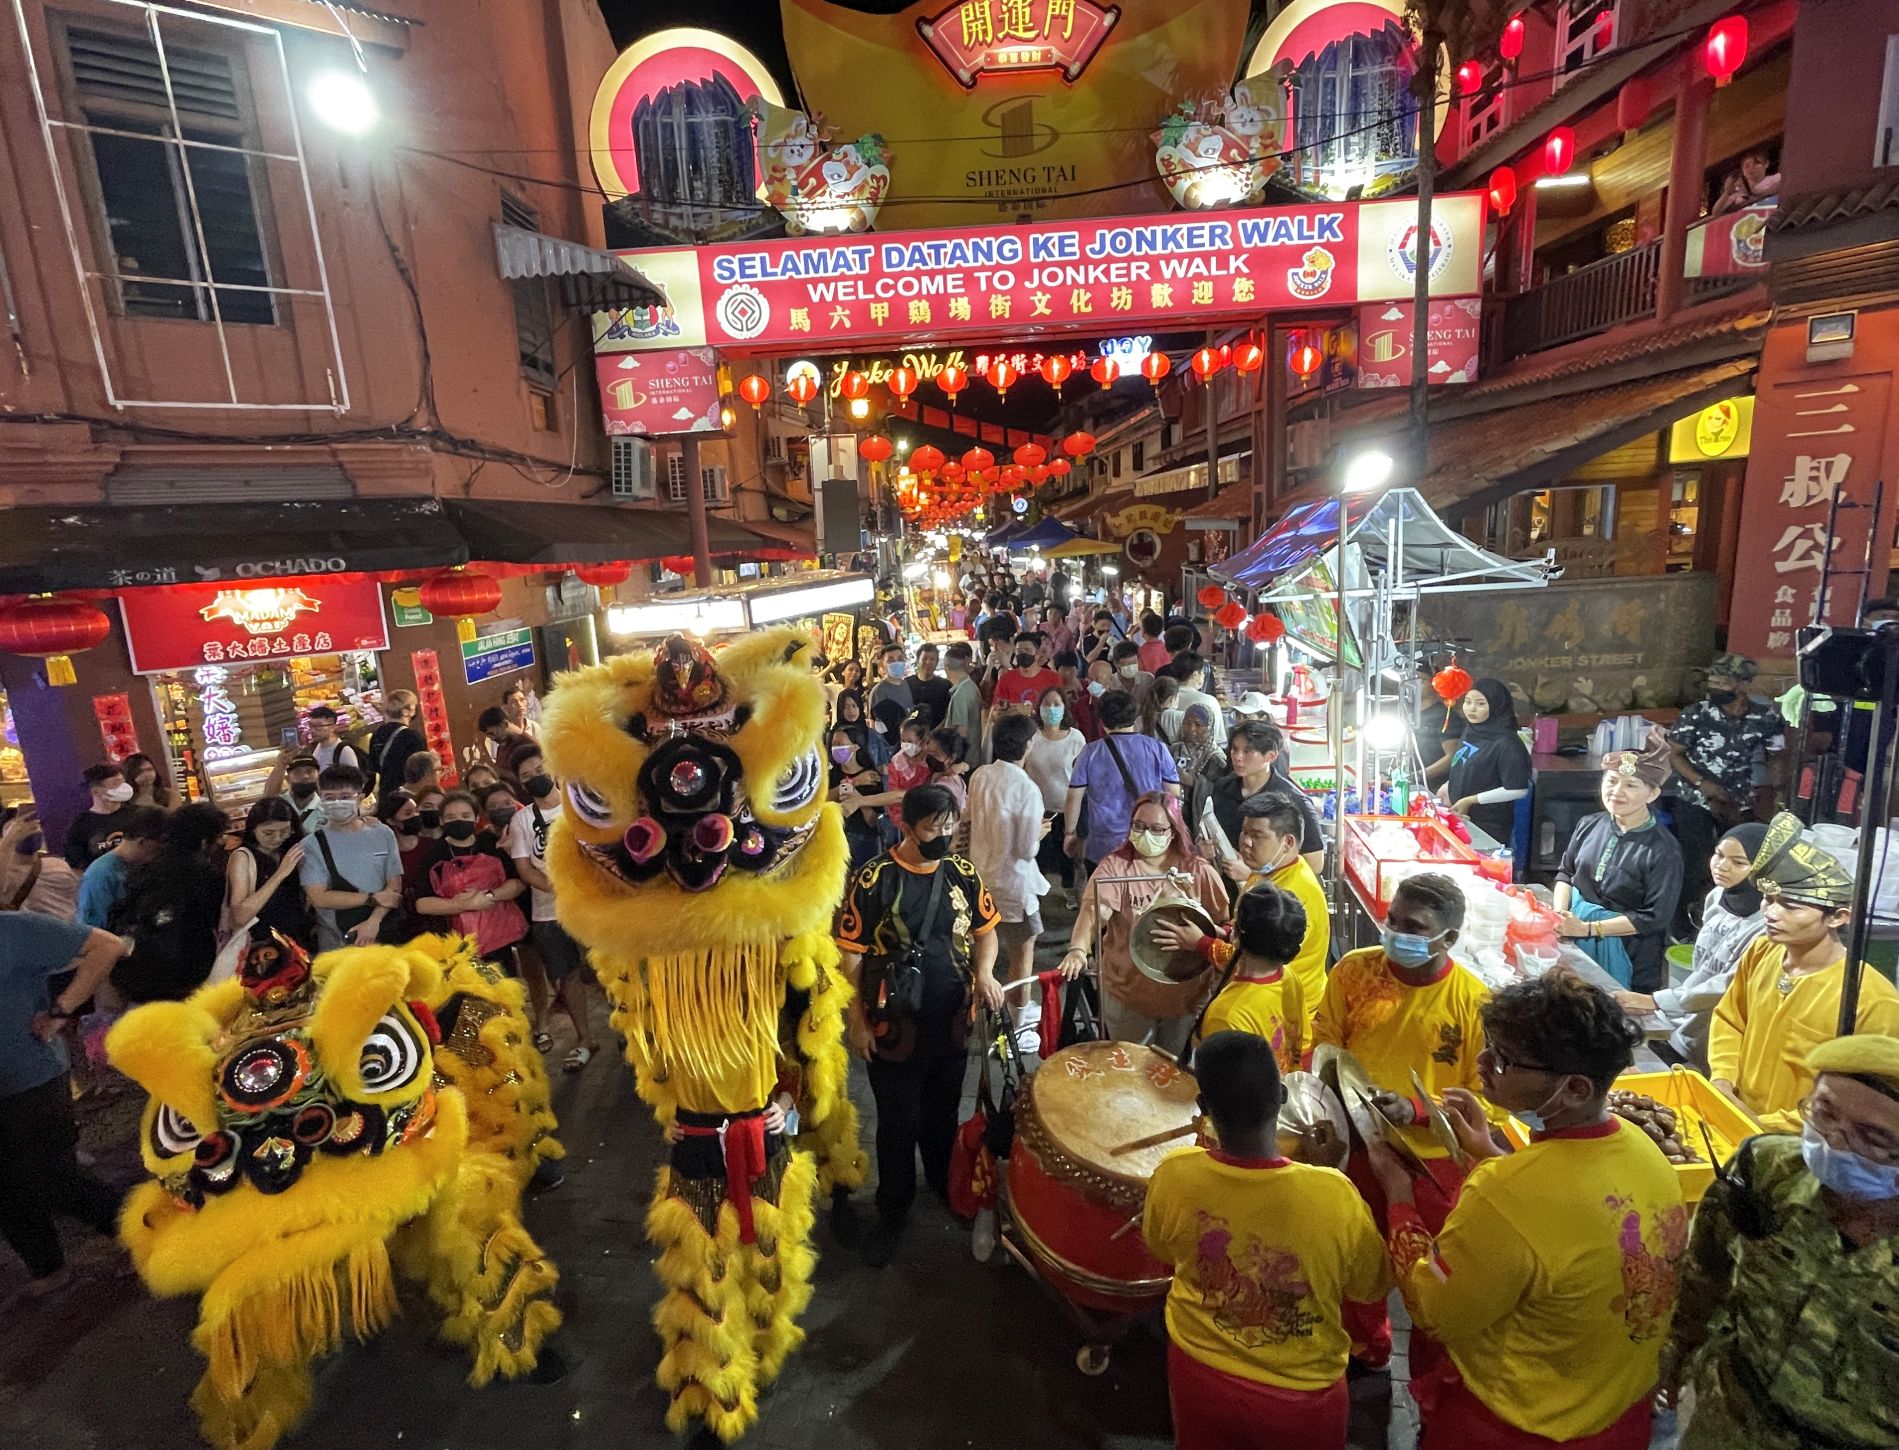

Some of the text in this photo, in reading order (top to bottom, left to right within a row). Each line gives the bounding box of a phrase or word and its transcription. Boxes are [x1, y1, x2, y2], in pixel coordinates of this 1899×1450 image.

[961, 0, 1076, 49] 開運門
[966, 165, 1077, 188] SHENG TAI
[984, 186, 1058, 199] INTERNATIONAL
[715, 213, 1343, 282] SELAMAT DATANG KE JONKER WALK
[807, 254, 1250, 303] WELCOME TO JONKER WALK
[1409, 327, 1475, 341] SENG TAI
[648, 374, 713, 389] SHENG TAI
[1773, 383, 1859, 574] 三叔公
[108, 567, 177, 585] 茶の道
[235, 557, 346, 578] OCHADO
[236, 607, 293, 622] MADAM
[478, 632, 520, 651] JALAN HANG JEBAT
[1504, 652, 1644, 669] JONKER STREET
